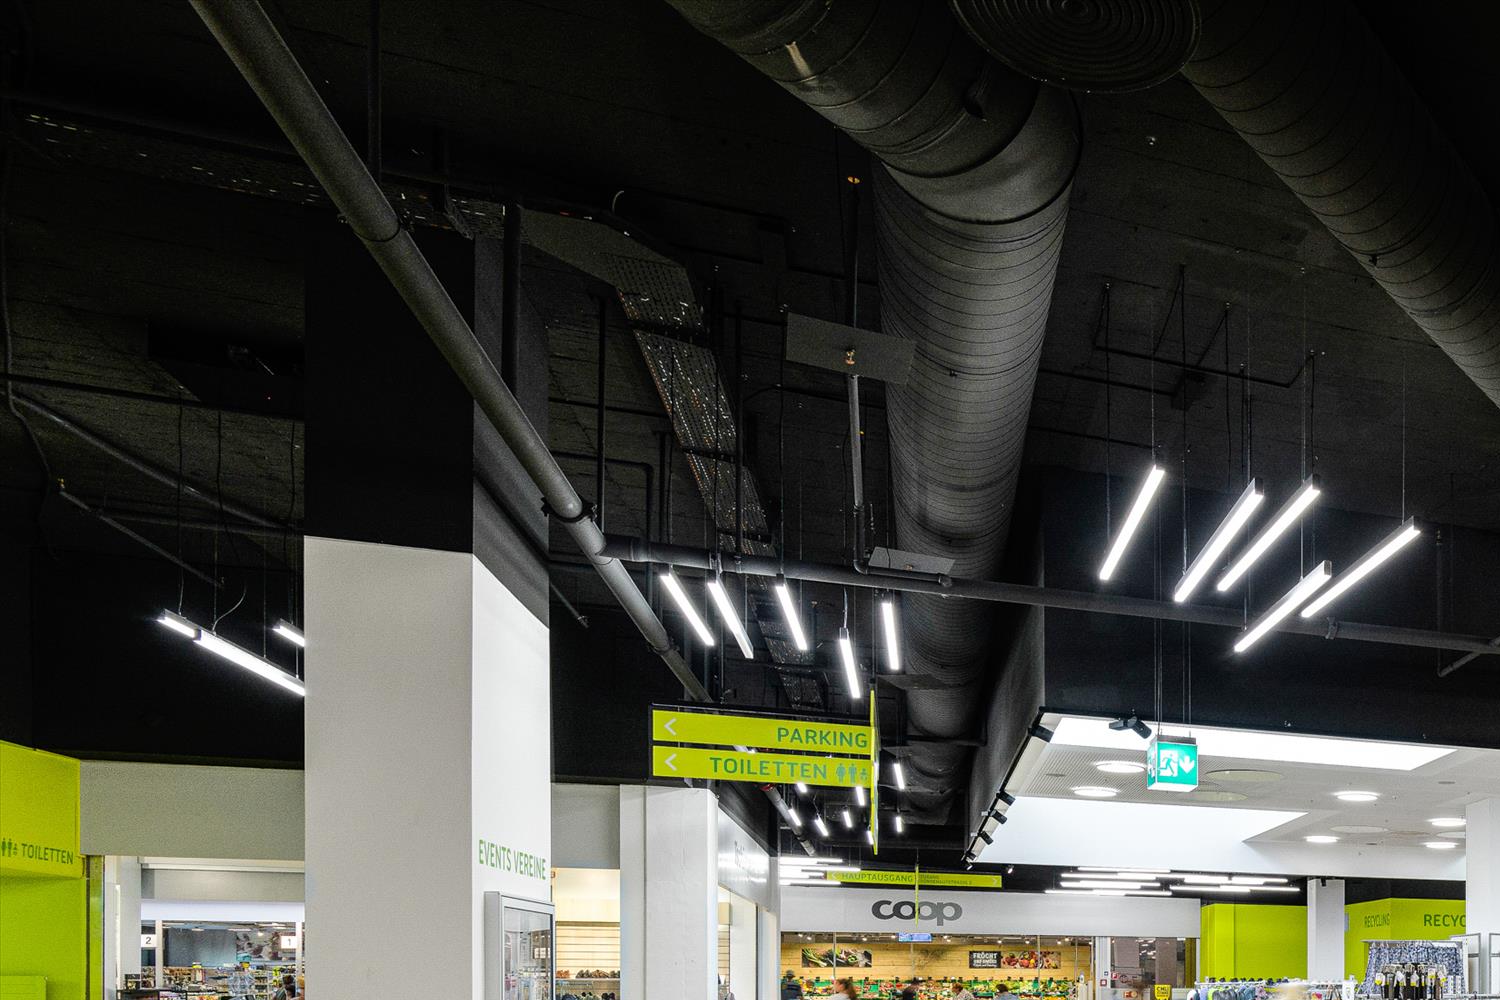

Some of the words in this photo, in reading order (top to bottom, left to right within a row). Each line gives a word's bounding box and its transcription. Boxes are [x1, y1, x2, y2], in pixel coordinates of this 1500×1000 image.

[777, 727, 868, 748] PARKING
[709, 757, 827, 780] TOILETTEN
[21, 843, 74, 865] TOILETTEN
[478, 839, 512, 872] EVENTS
[513, 850, 546, 880] VEREINE
[842, 871, 913, 883] HAUPTAUSGANG
[871, 899, 963, 926] coop
[1364, 913, 1391, 928] RECYCLING
[145, 936, 152, 945] 2
